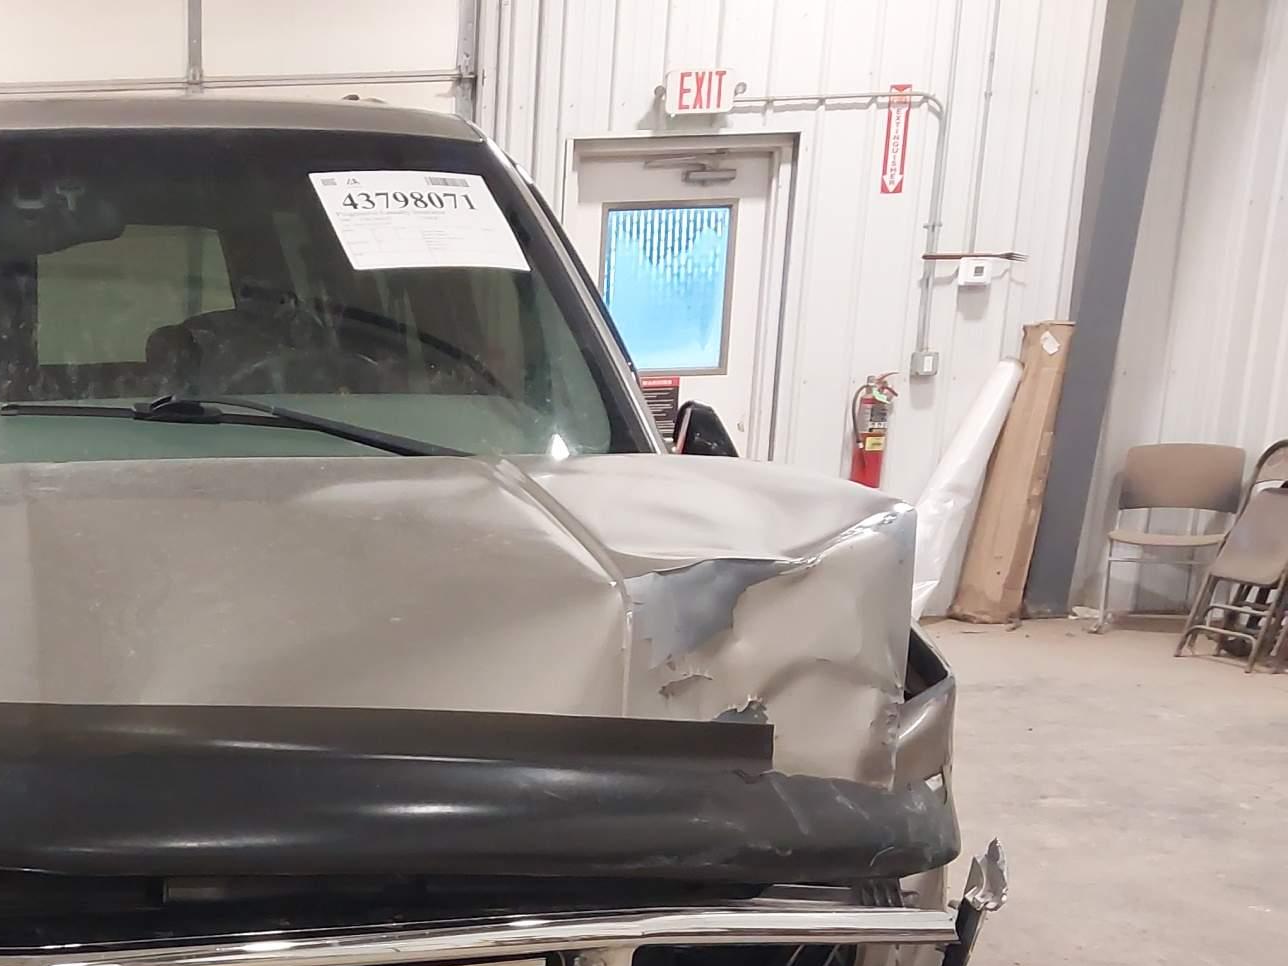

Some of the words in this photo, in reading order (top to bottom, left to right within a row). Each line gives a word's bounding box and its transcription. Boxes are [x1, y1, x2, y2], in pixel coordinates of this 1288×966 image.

[678, 70, 727, 110] EXIT
[889, 108, 902, 185] EXTINGUISHER
[342, 191, 476, 210] 43798071
